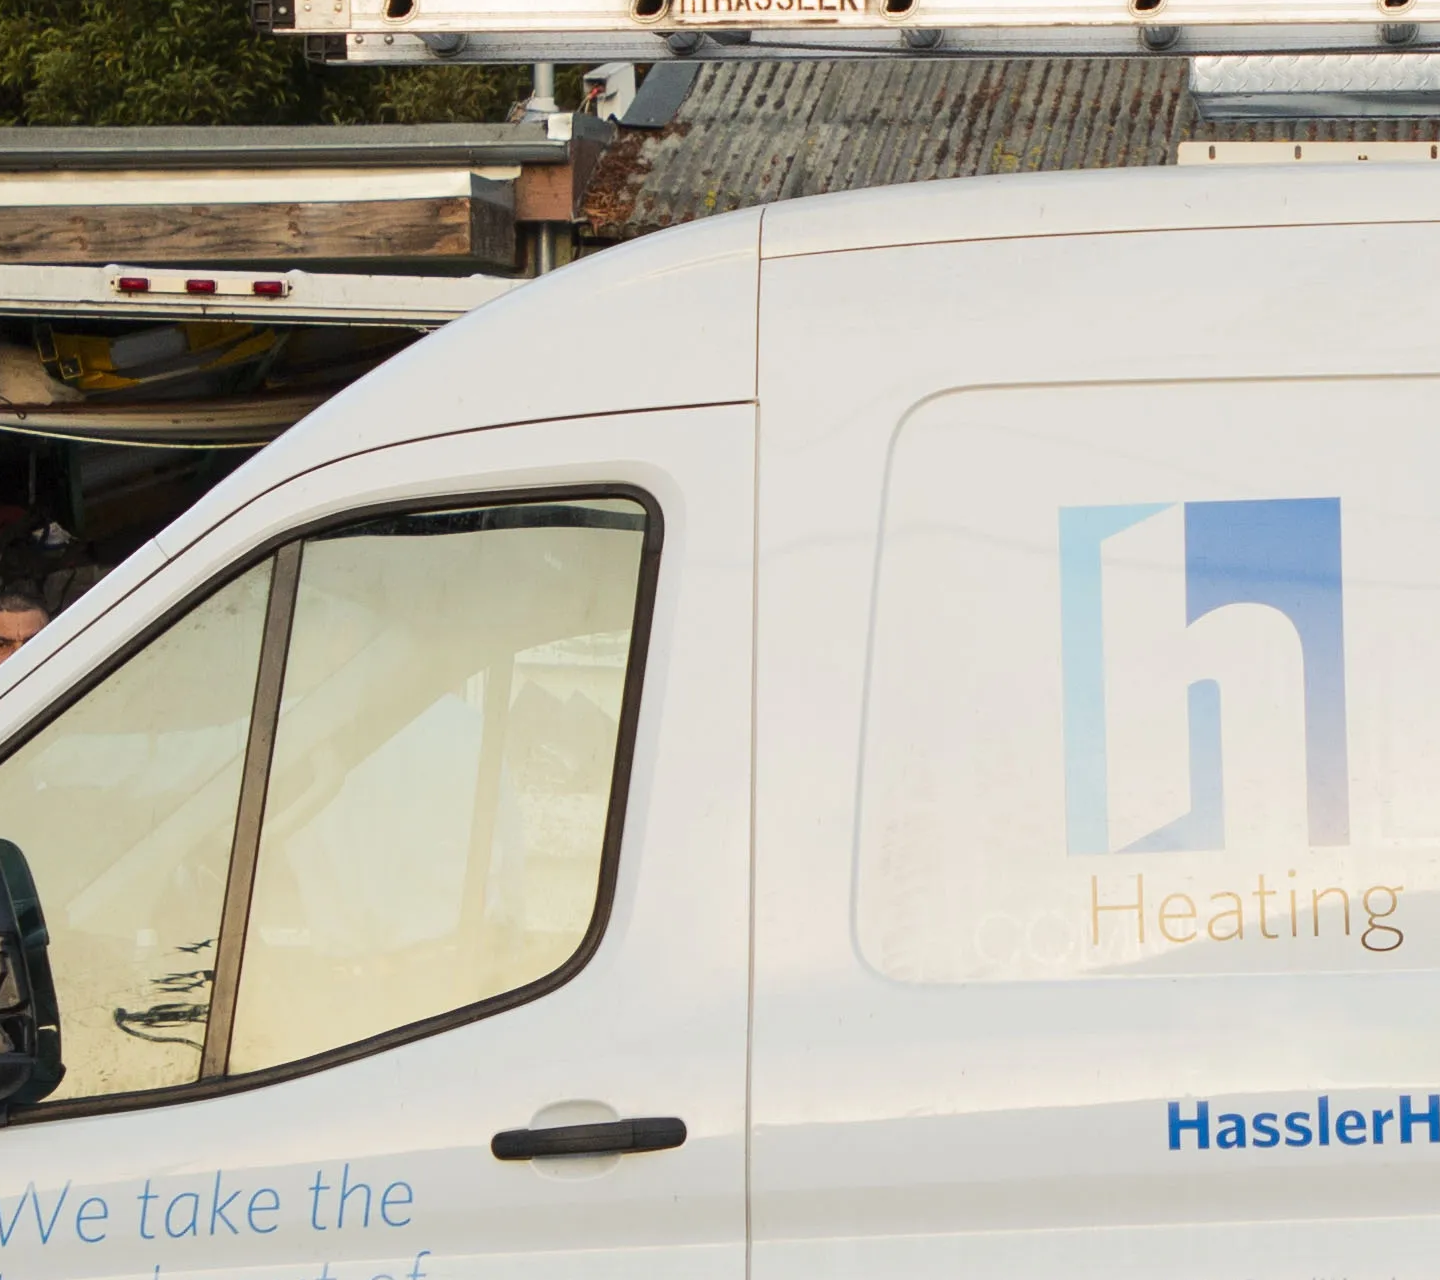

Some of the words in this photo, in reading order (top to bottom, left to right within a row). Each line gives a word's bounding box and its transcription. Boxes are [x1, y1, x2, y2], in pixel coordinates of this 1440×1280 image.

[1090, 868, 1404, 952] Heating
[136, 1169, 281, 1240] take
[309, 1163, 414, 1231] the
